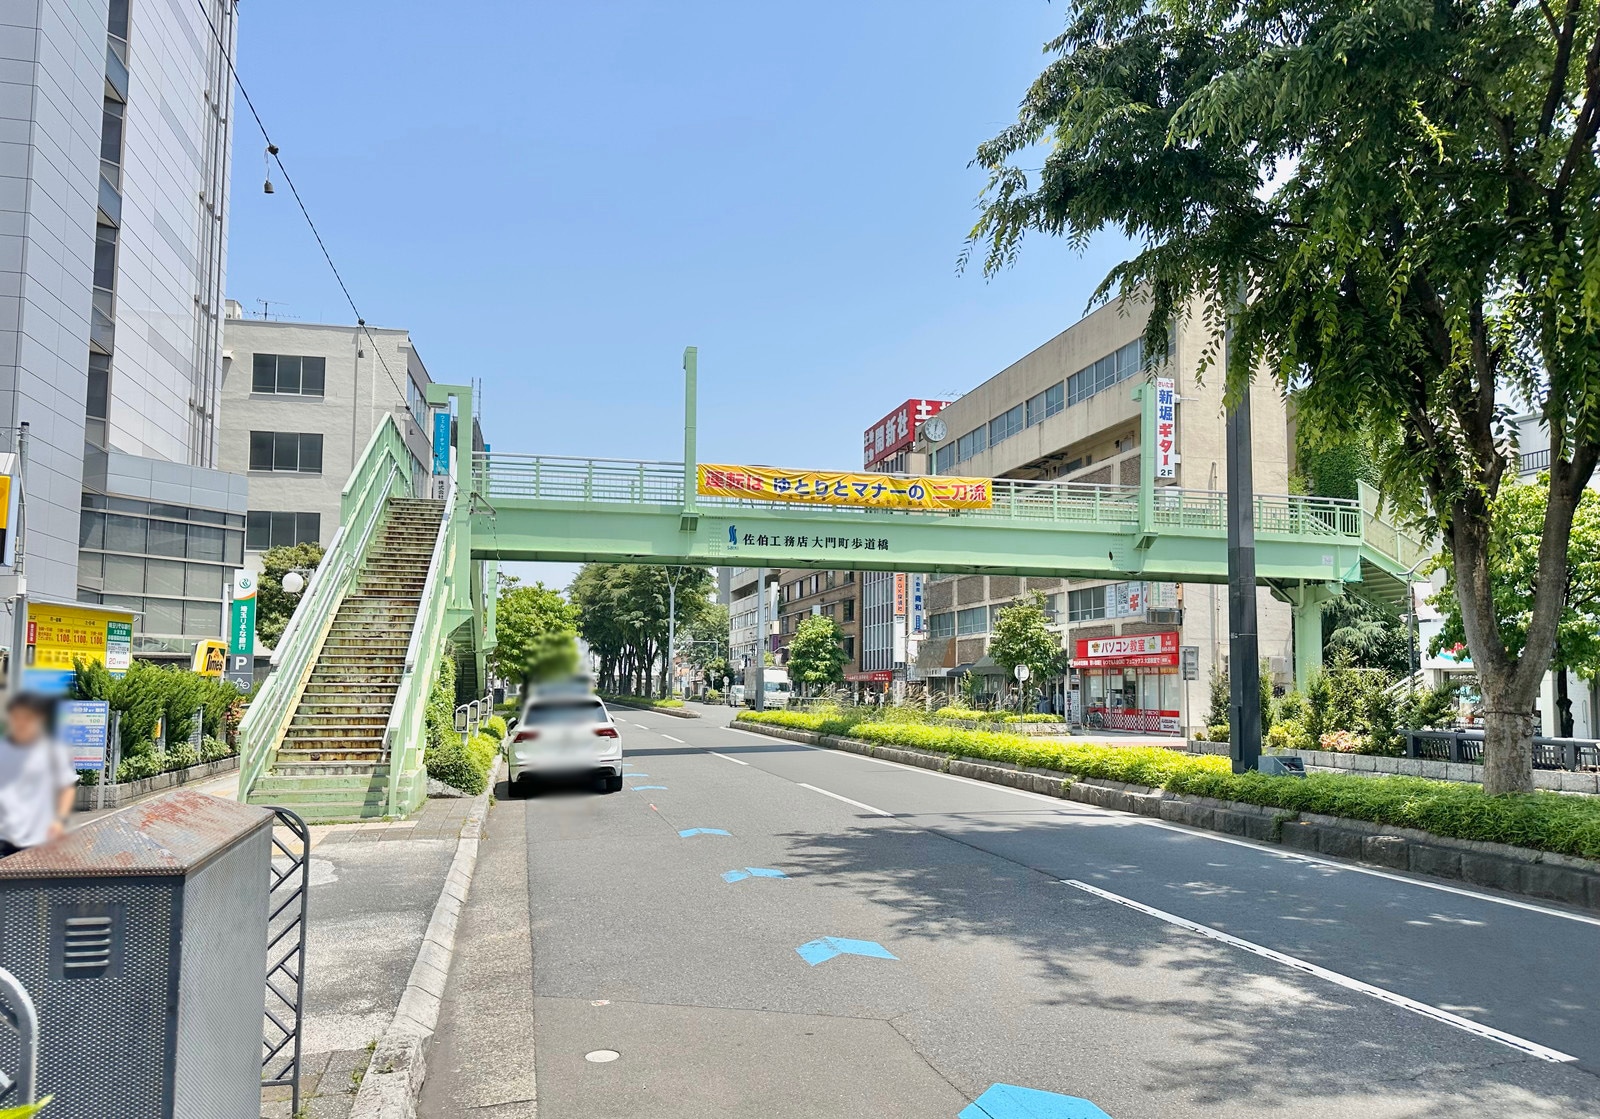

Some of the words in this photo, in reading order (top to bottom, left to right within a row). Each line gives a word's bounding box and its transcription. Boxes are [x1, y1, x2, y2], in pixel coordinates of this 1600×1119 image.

[1159, 389, 1173, 466] 新堀ギター
[705, 469, 764, 491] 運転は
[773, 477, 925, 501] ゆとりとマナーの
[932, 484, 987, 502] 二刀流
[238, 605, 248, 651] 埼玉りそな銀行
[235, 656, 248, 670] P
[1101, 639, 1146, 654] パソコン教室
